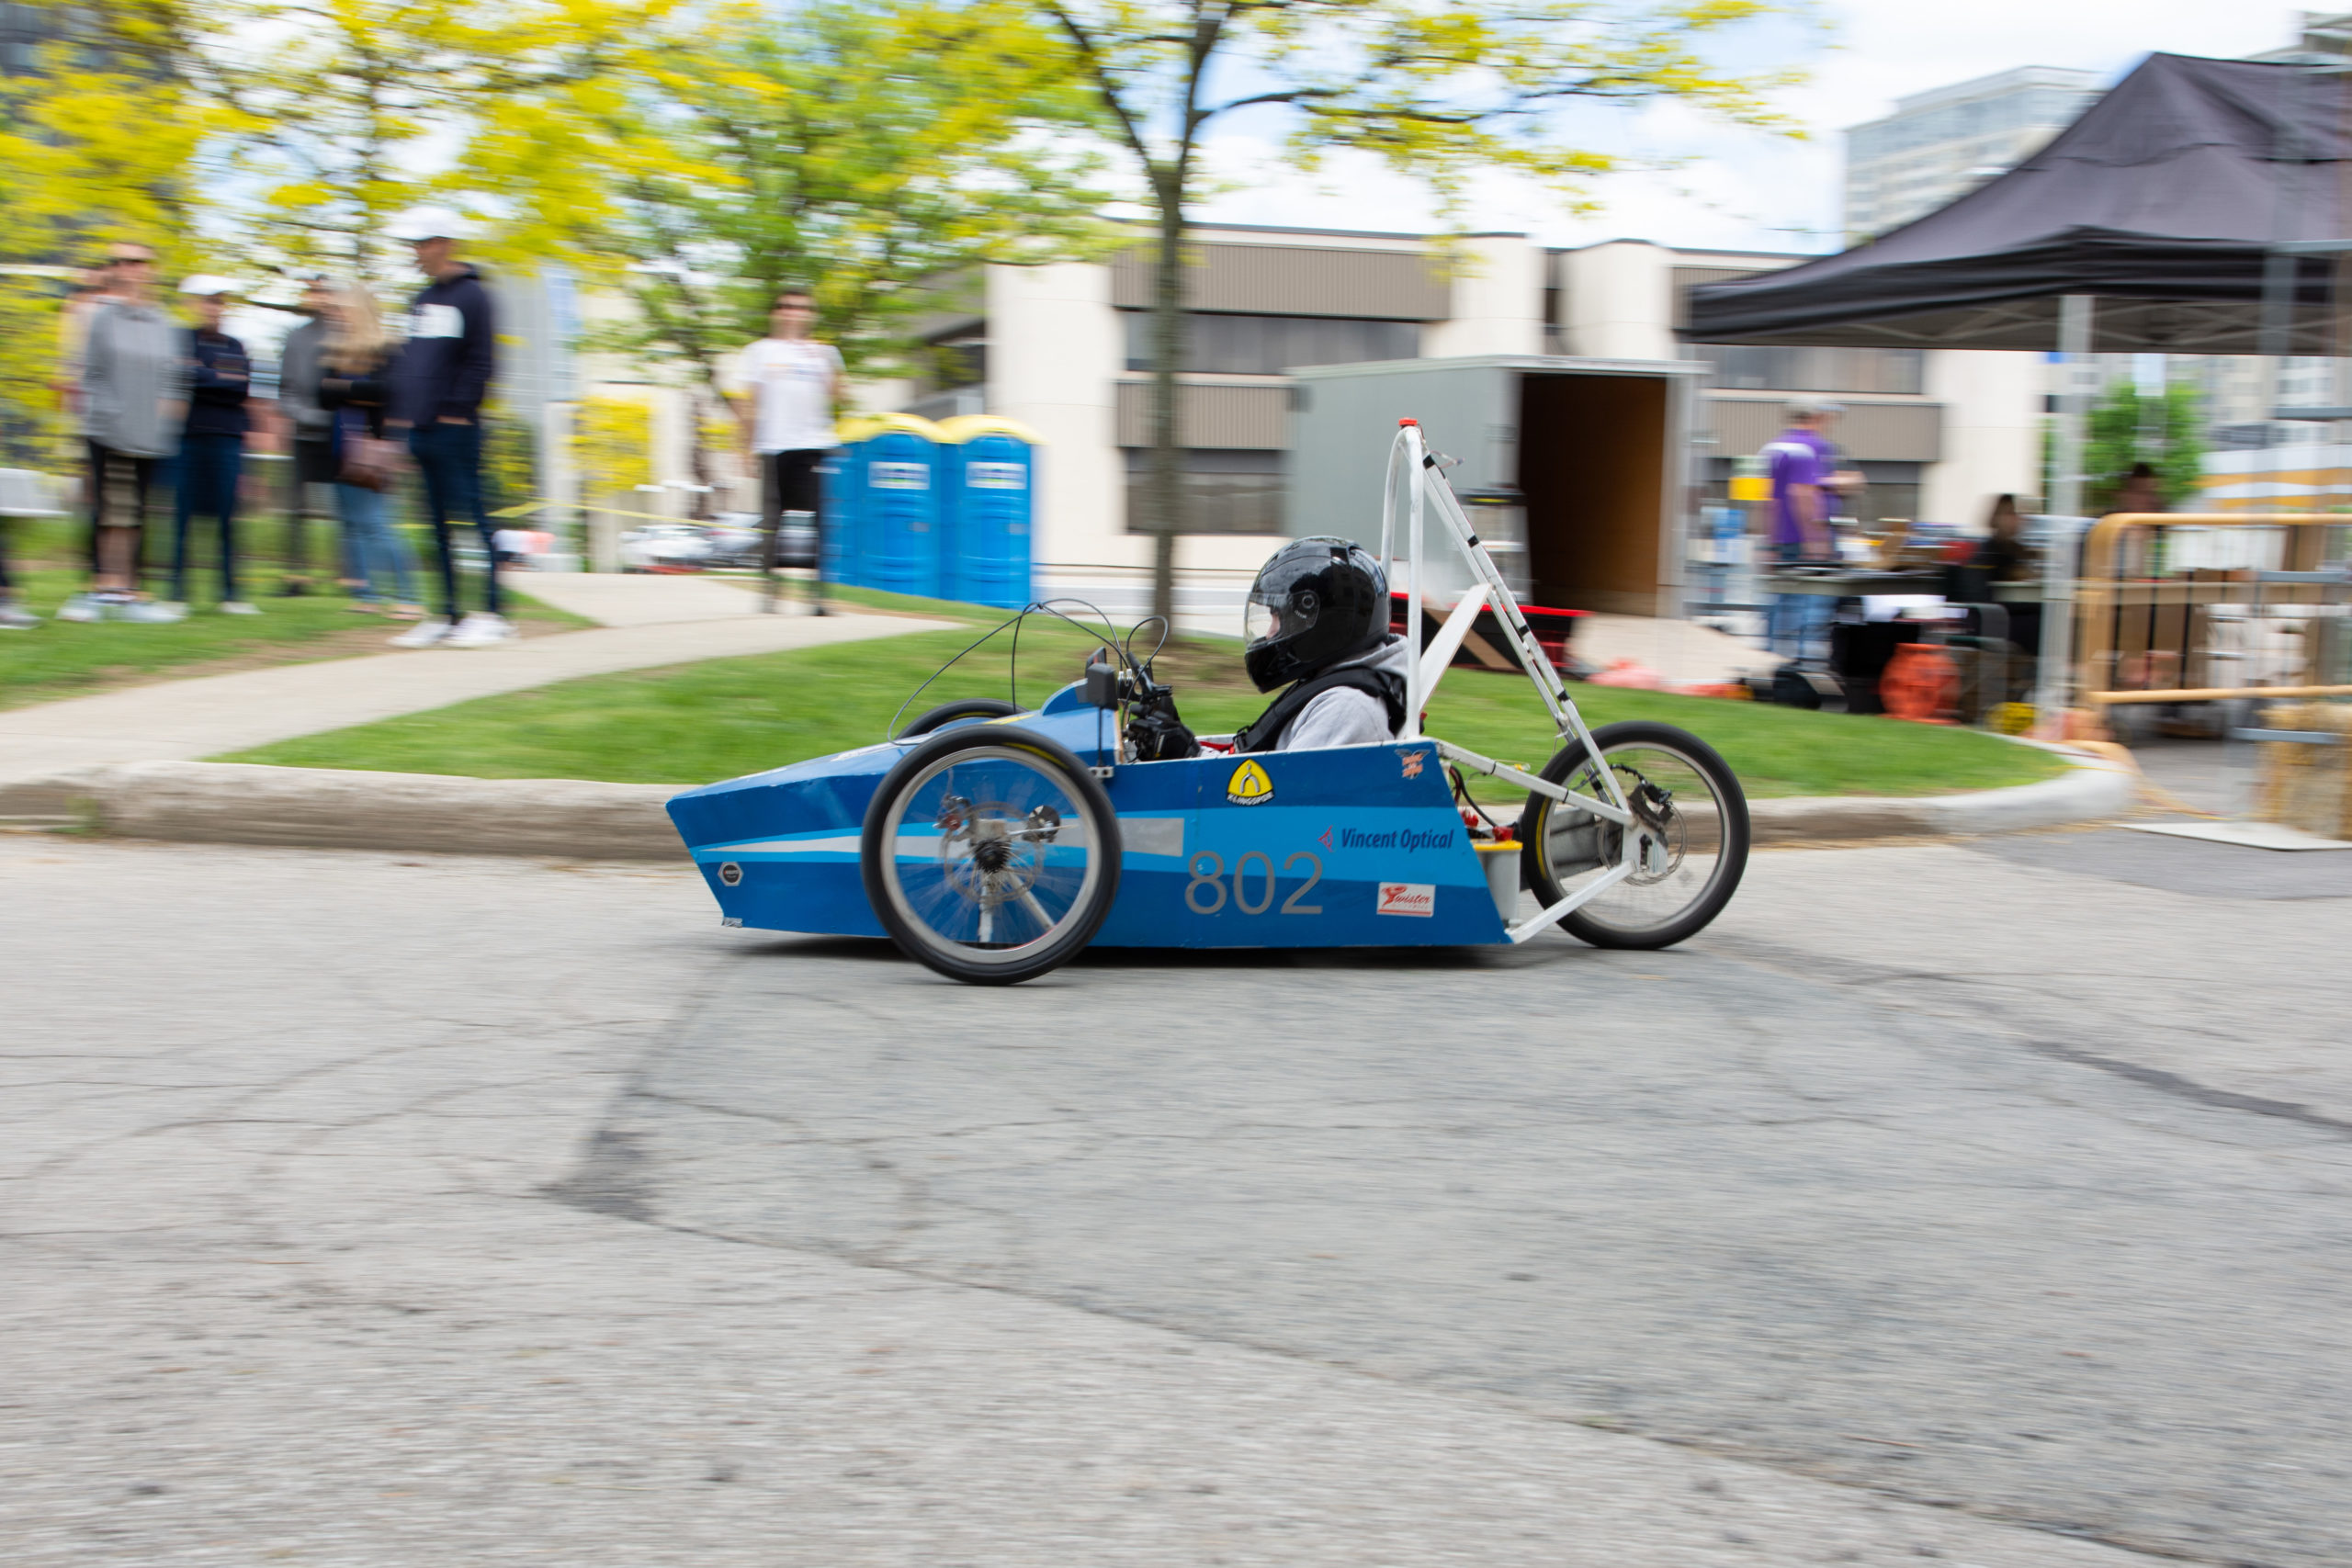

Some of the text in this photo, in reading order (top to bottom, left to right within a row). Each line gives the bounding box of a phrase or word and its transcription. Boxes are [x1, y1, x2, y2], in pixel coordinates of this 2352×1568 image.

[1227, 792, 1274, 806] KLINGSPOR
[1341, 829, 1454, 852] Vincent Optical
[1185, 851, 1323, 915] 802
